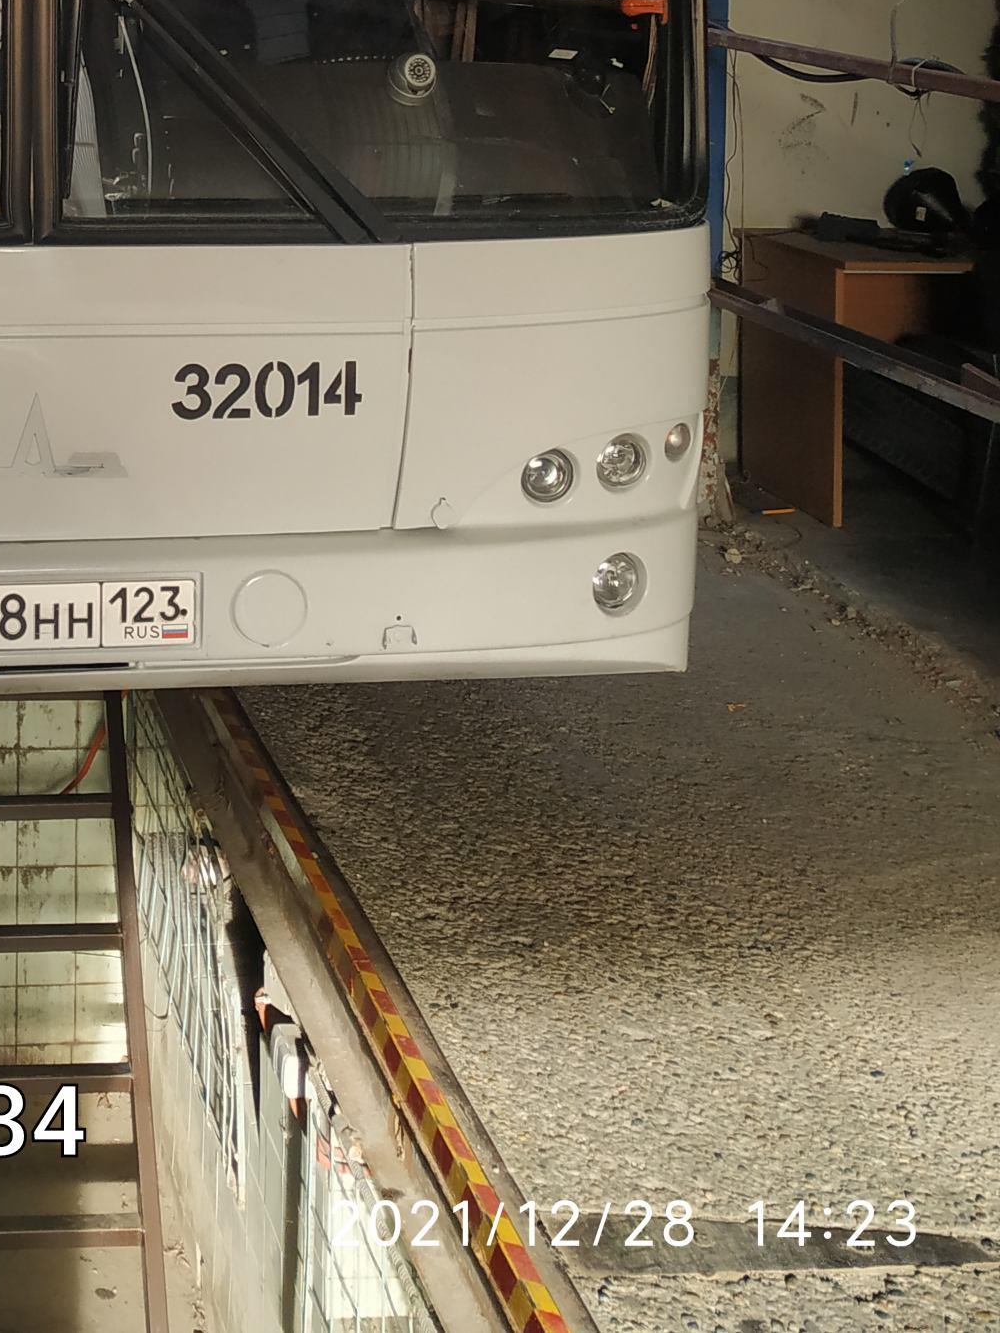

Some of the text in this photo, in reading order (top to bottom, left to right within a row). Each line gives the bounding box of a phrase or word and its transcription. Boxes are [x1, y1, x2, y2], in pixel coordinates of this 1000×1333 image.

[171, 361, 362, 420] 32014
[109, 586, 181, 623] 123
[124, 626, 160, 639] RUS
